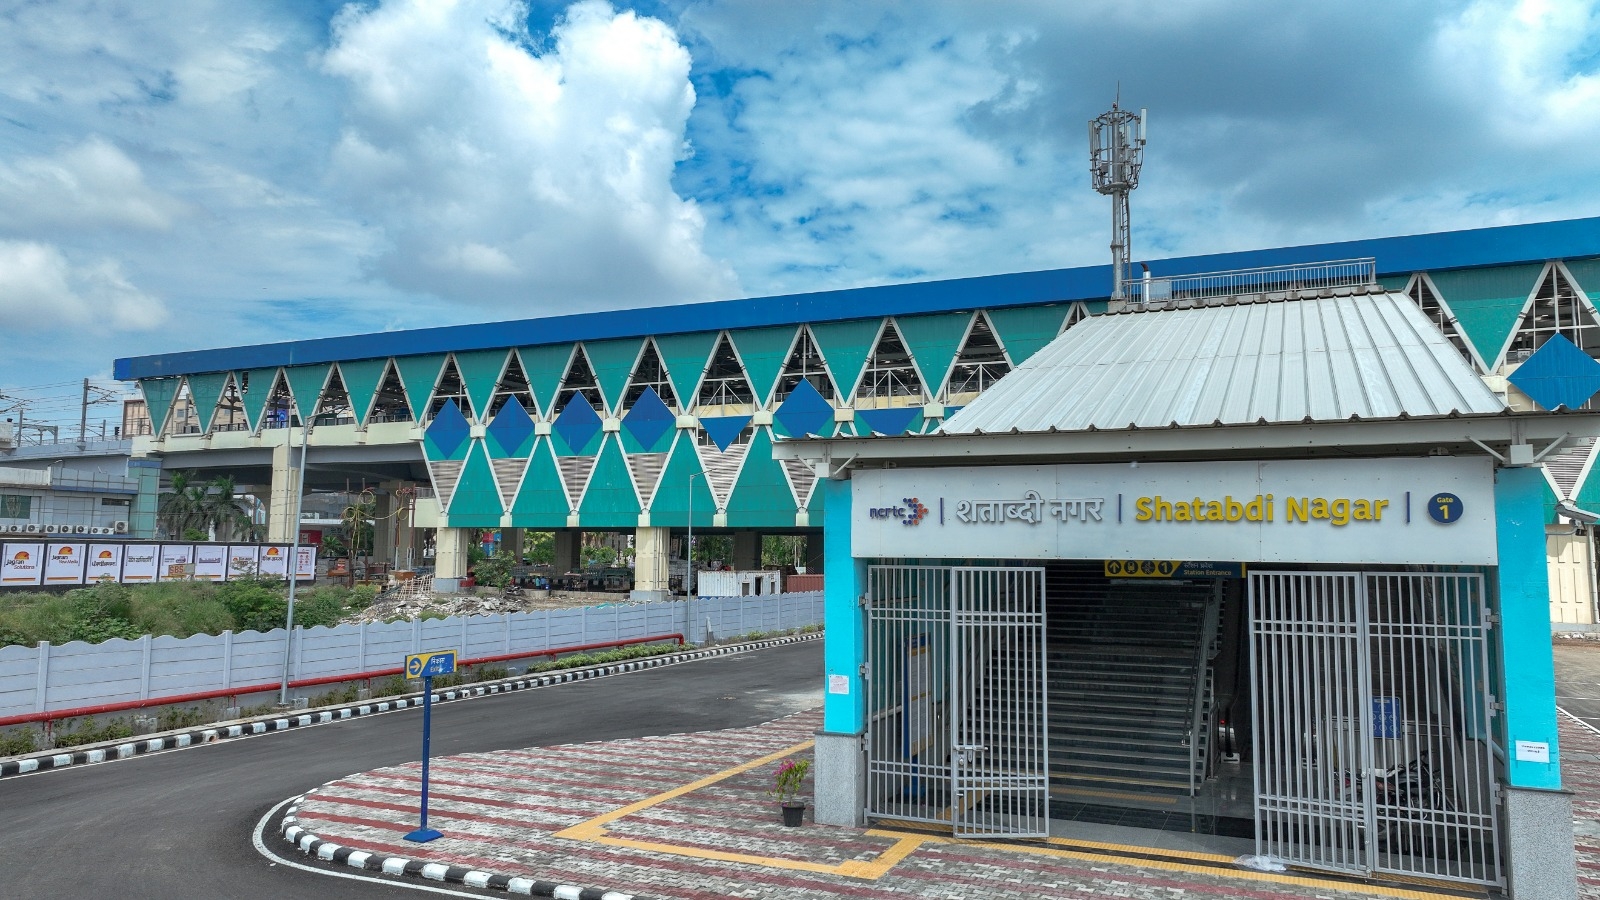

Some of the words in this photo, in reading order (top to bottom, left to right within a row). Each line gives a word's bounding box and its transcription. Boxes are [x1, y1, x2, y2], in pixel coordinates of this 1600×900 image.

[870, 505, 906, 518] ncrtc
[956, 490, 1044, 526] शताब्दी
[1050, 497, 1105, 524] नगर
[1136, 494, 1275, 523] Shatabdi
[1287, 496, 1389, 527] Nagar
[1439, 504, 1449, 520] 1
